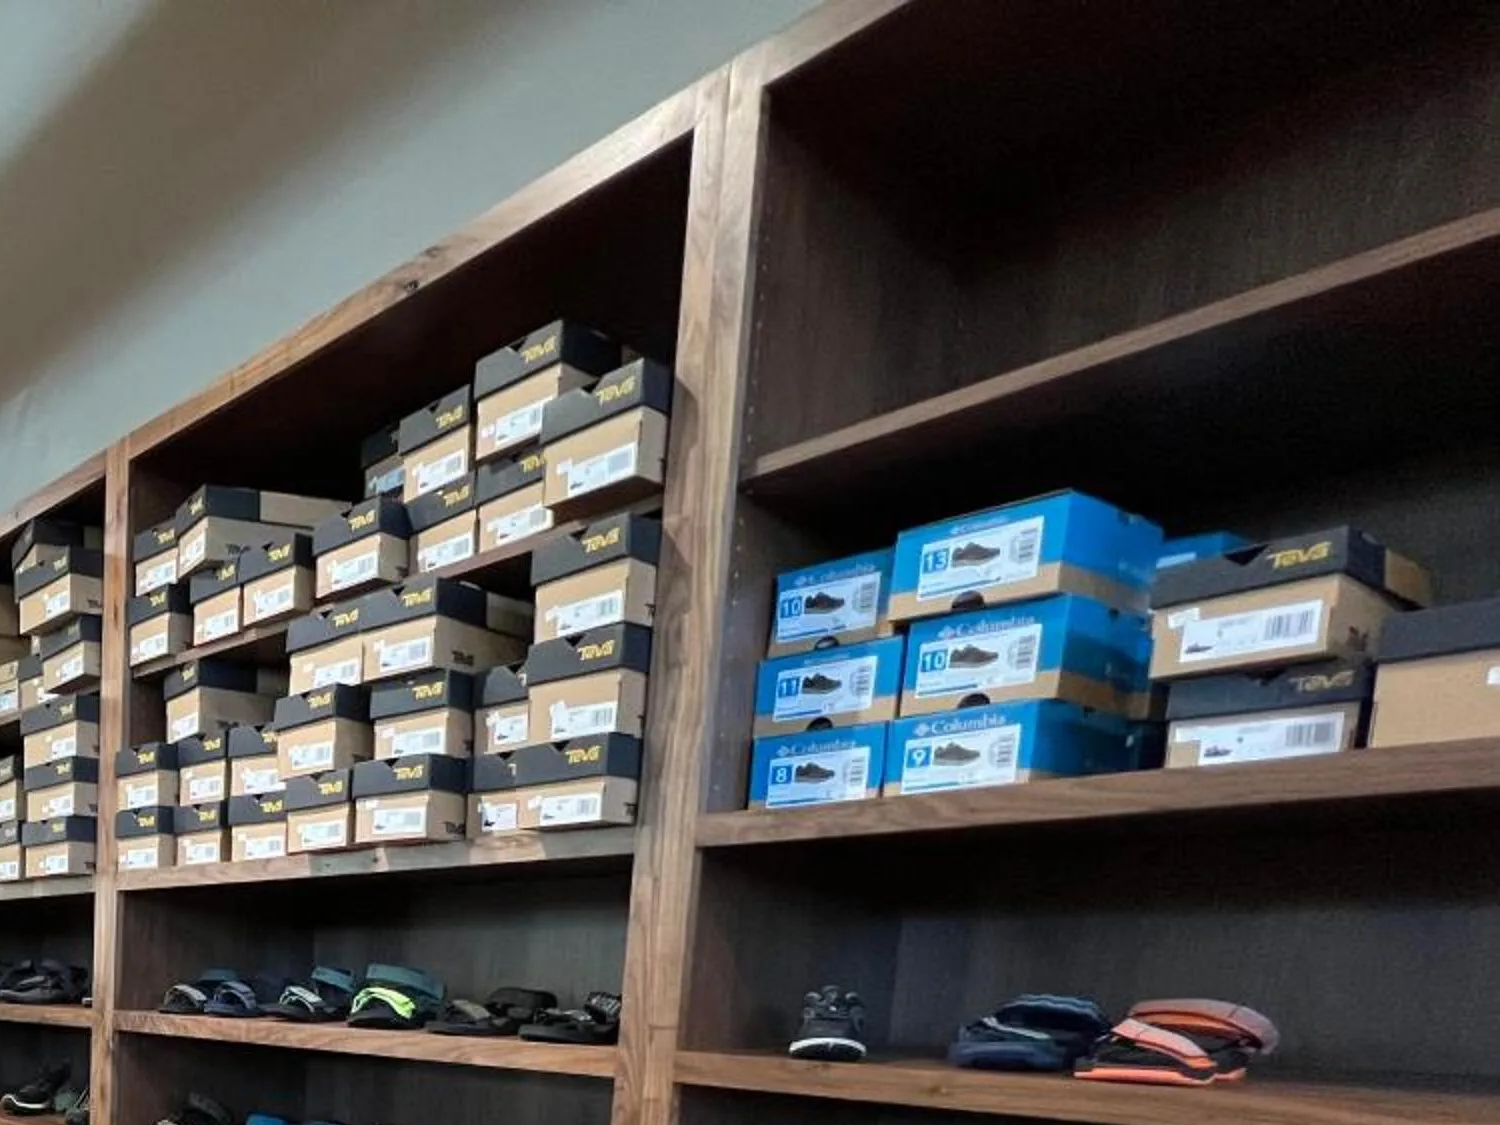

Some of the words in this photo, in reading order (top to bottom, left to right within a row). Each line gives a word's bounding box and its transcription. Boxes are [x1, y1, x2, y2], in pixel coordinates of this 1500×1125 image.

[925, 552, 946, 571] 13
[1265, 541, 1332, 569] Teva
[783, 601, 801, 617] 10
[923, 653, 946, 670] 10
[913, 749, 926, 765] 9
[776, 768, 786, 782] 8
